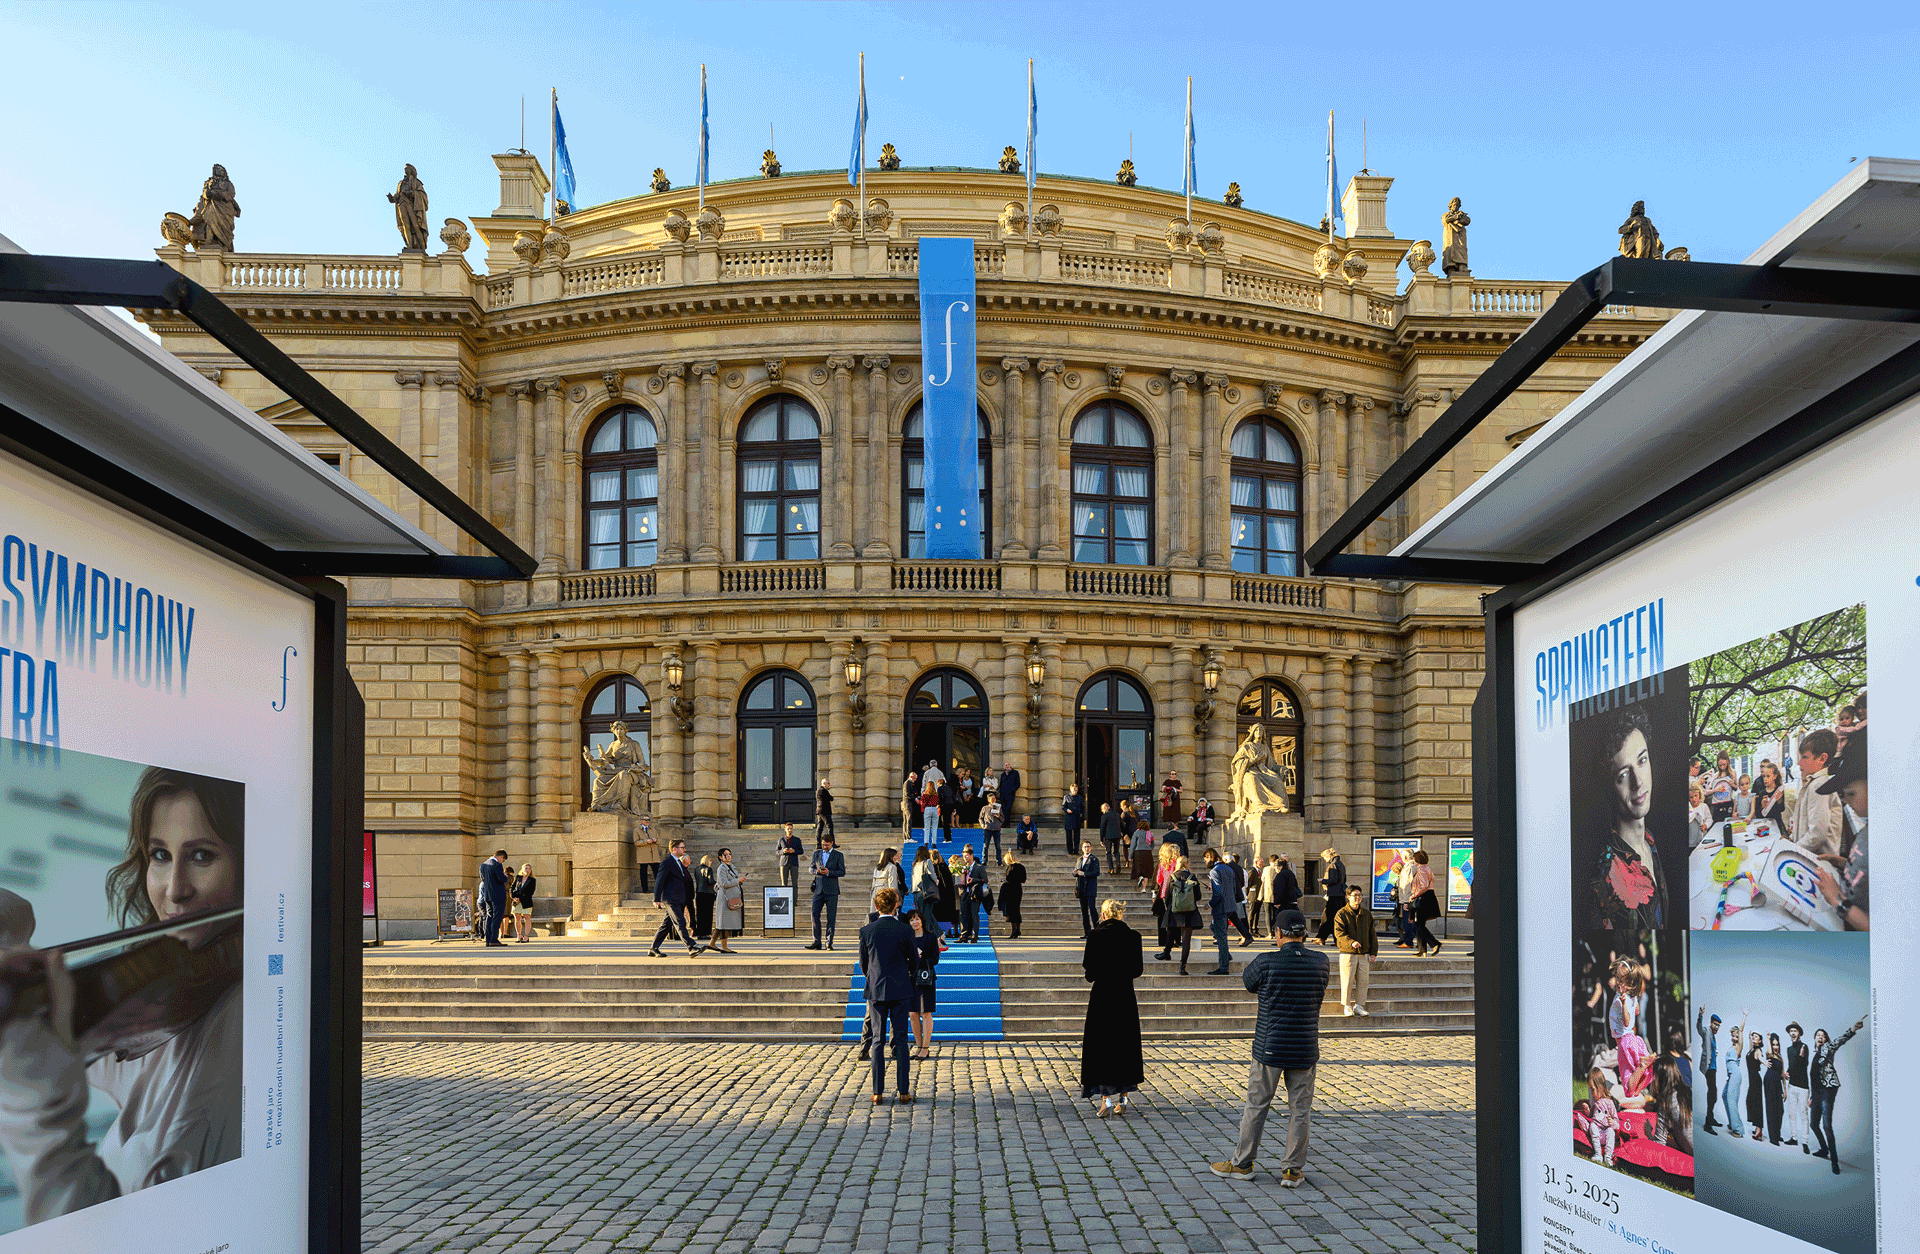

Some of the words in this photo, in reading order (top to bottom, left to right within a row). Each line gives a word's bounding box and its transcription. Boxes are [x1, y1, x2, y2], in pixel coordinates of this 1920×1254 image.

[1, 534, 195, 699] SYMPHONY
[1535, 597, 1665, 733] SPRINGTEEN
[276, 1025, 284, 1065] hudební
[267, 1087, 275, 1107] jaro
[265, 1109, 273, 1150] Pražské
[275, 1129, 283, 1146] 80.
[1543, 1163, 1560, 1186] 31.
[1565, 1174, 1577, 1194] 5.
[1582, 1180, 1620, 1215] 2025
[1543, 1191, 1573, 1215] Anežský
[1574, 1204, 1601, 1226] klášter
[1608, 1220, 1617, 1234] St
[1543, 1215, 1575, 1237] KONCERTY
[1543, 1229, 1554, 1240] Jan
